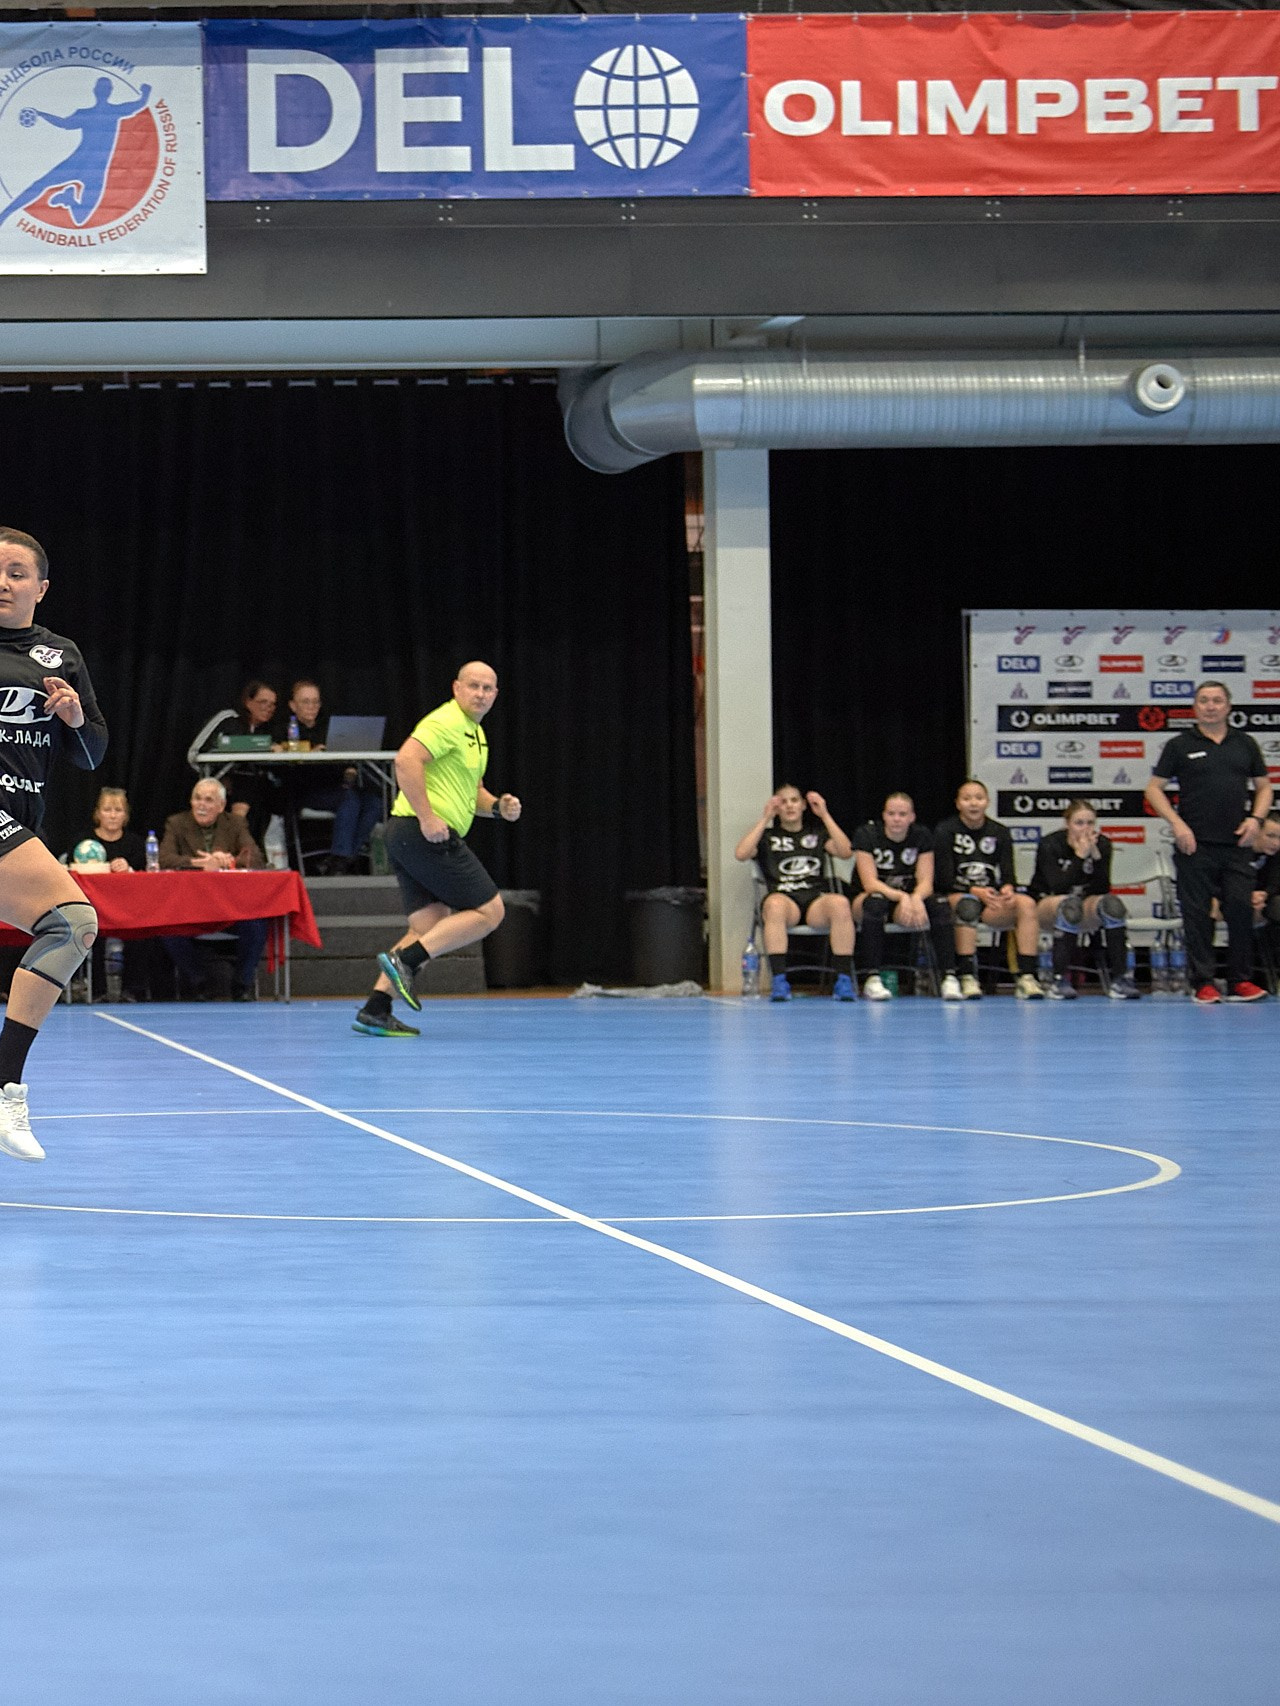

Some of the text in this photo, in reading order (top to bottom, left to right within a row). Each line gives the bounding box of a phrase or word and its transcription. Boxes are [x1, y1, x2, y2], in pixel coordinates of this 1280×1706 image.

[67, 46, 136, 76] РОССИИ
[763, 75, 1279, 138] OLIMPBET
[16, 98, 178, 248] HANDBALL FEDERATION OF RUSSIA
[1032, 712, 1120, 725] OLIMPBET
[769, 835, 795, 852] 25
[872, 847, 895, 870] 22
